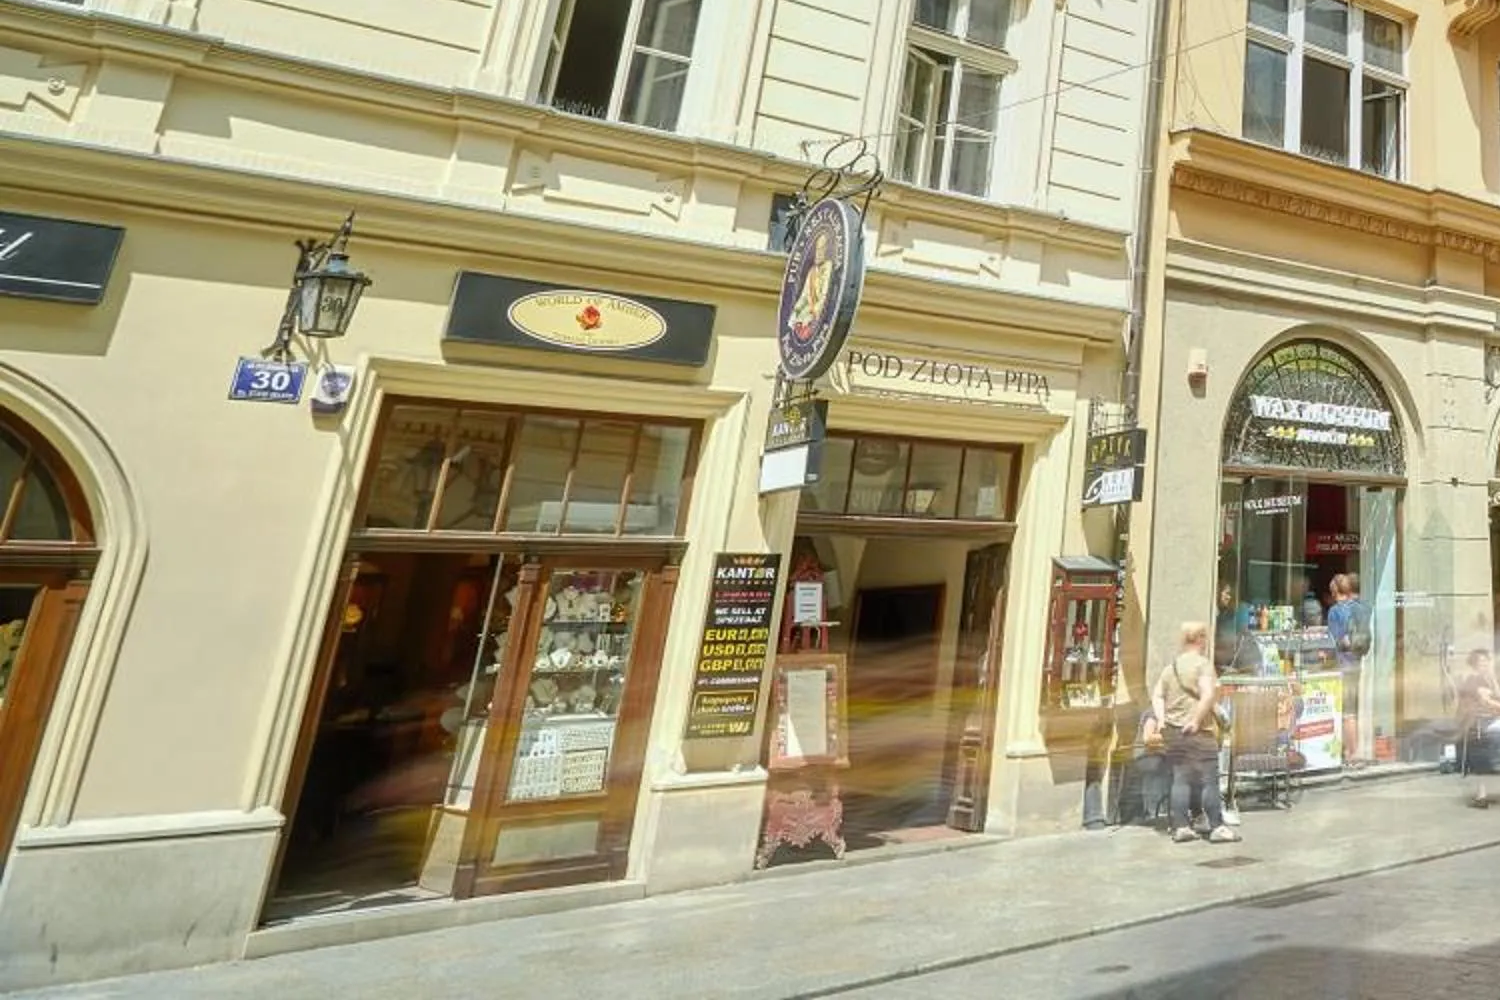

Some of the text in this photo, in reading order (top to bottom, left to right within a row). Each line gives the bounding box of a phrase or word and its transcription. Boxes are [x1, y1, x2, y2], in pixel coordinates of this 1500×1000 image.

[320, 295, 343, 314] 30
[250, 371, 291, 391] 30
[848, 351, 903, 379] POD
[909, 359, 993, 396] ZŁOTĄ
[704, 629, 737, 640] EUR
[703, 643, 735, 656] USD
[700, 659, 732, 671] GBP
